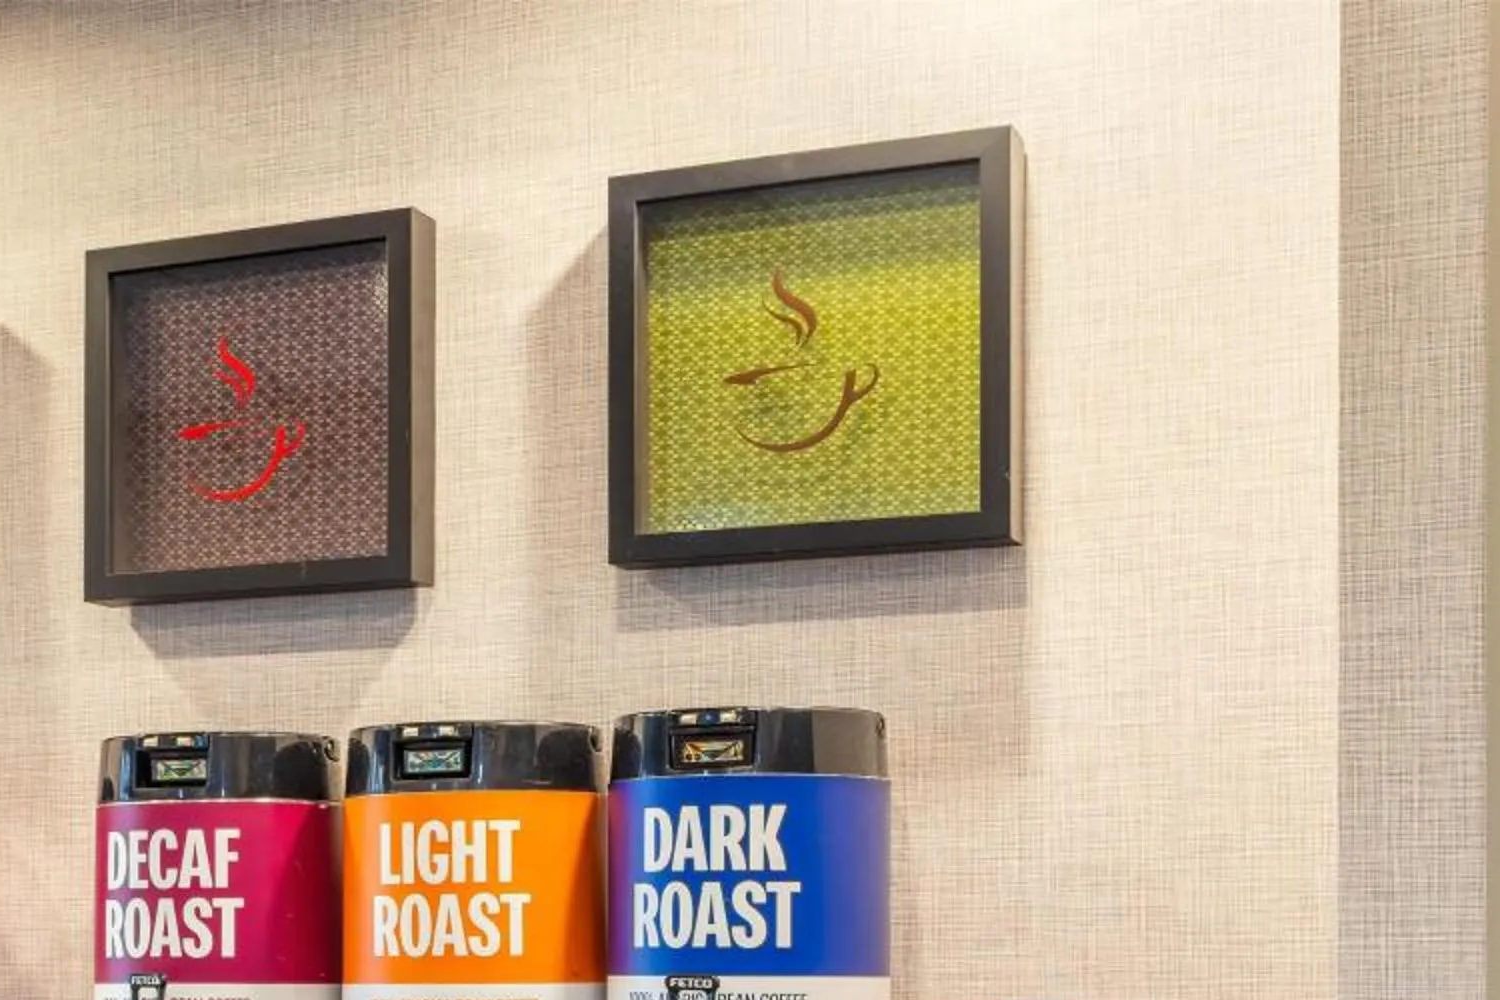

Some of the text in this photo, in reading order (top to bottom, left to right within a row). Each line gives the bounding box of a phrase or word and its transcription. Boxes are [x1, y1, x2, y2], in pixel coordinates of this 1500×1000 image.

[107, 828, 241, 890] DECAF
[379, 819, 521, 885] LIGHT
[644, 804, 787, 872] DARK
[105, 897, 244, 959] ROAST
[373, 893, 531, 957] ROAST
[633, 881, 802, 949] ROAST
[669, 977, 713, 988] FETCO
